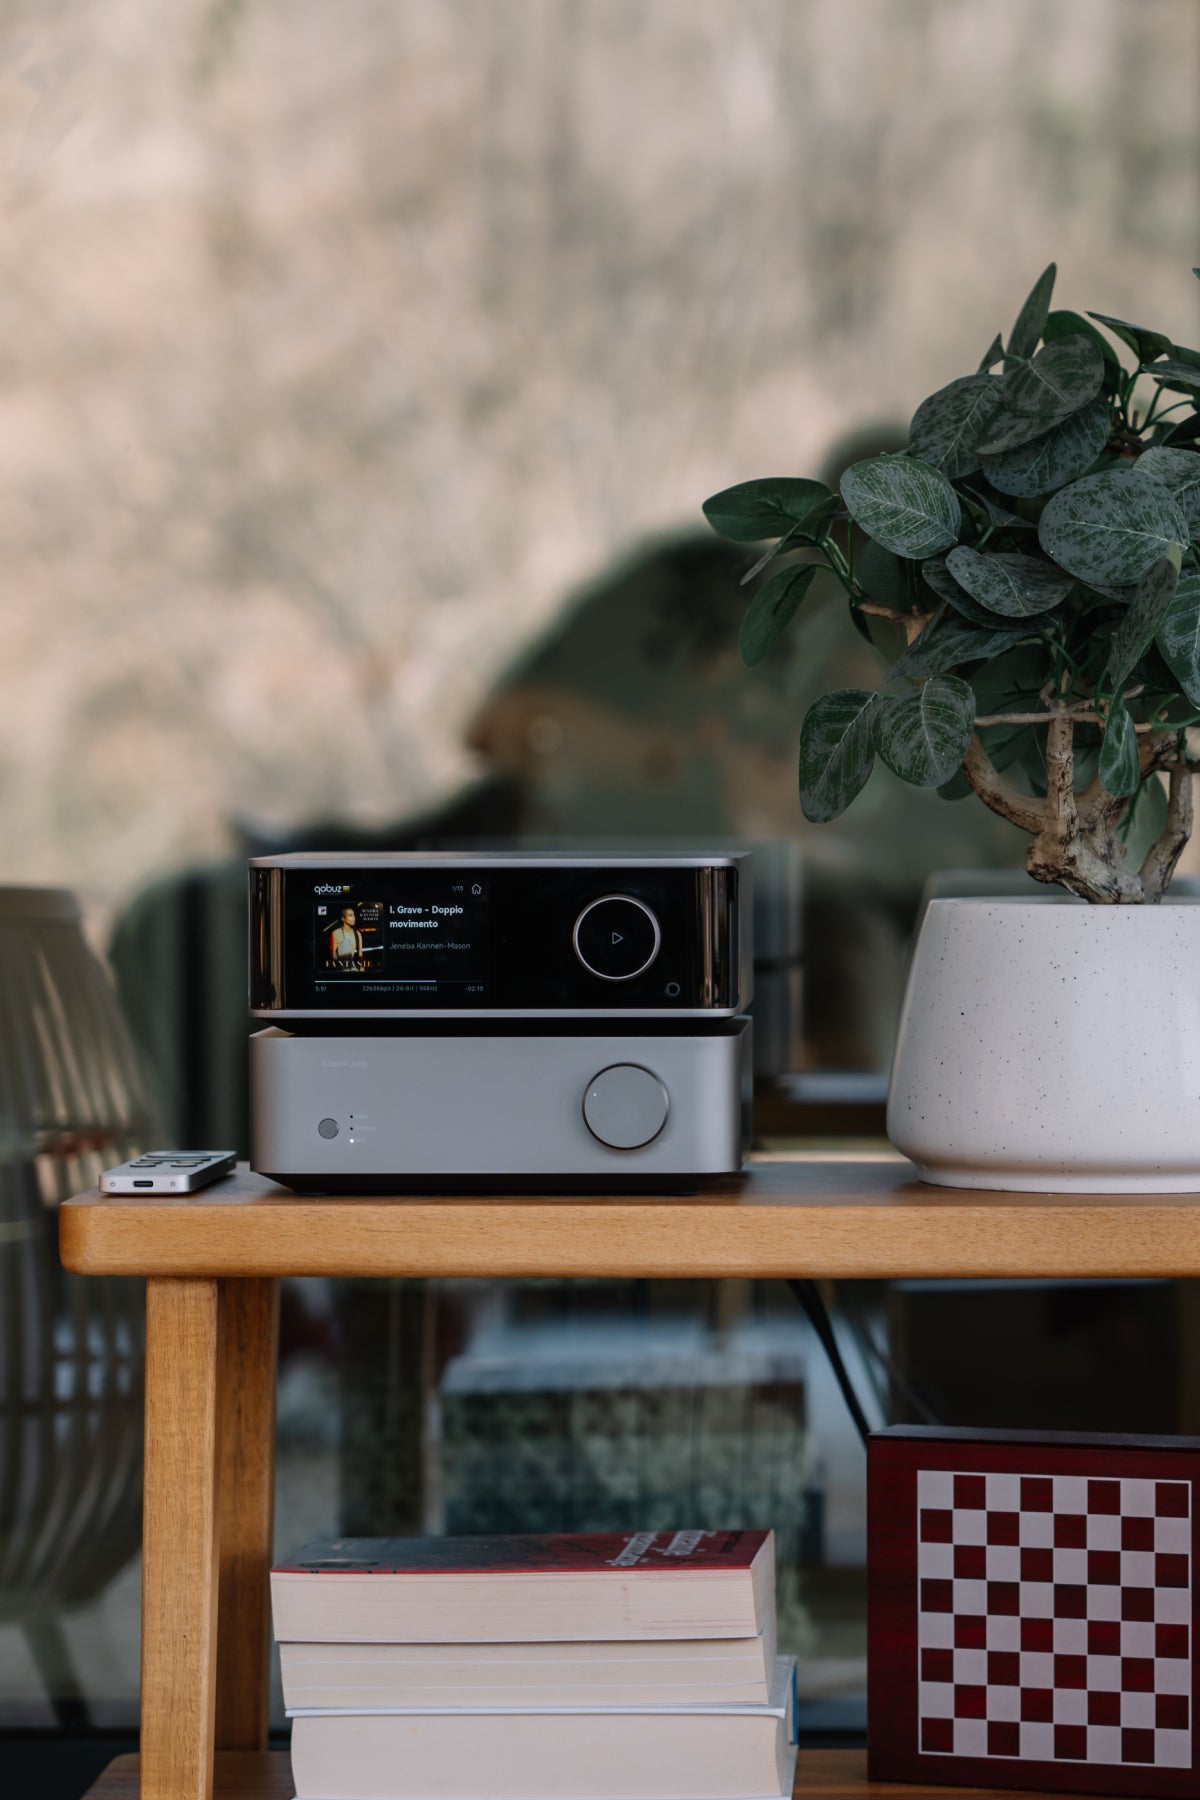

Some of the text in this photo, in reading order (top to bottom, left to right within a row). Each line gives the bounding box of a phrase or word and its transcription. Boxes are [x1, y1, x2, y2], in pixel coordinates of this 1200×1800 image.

[314, 883, 342, 895] qobuz
[397, 905, 422, 914] Grave
[431, 905, 463, 916] Doppio
[389, 919, 439, 928] movimento
[389, 942, 472, 950] Jeneba Kanneh-Mason
